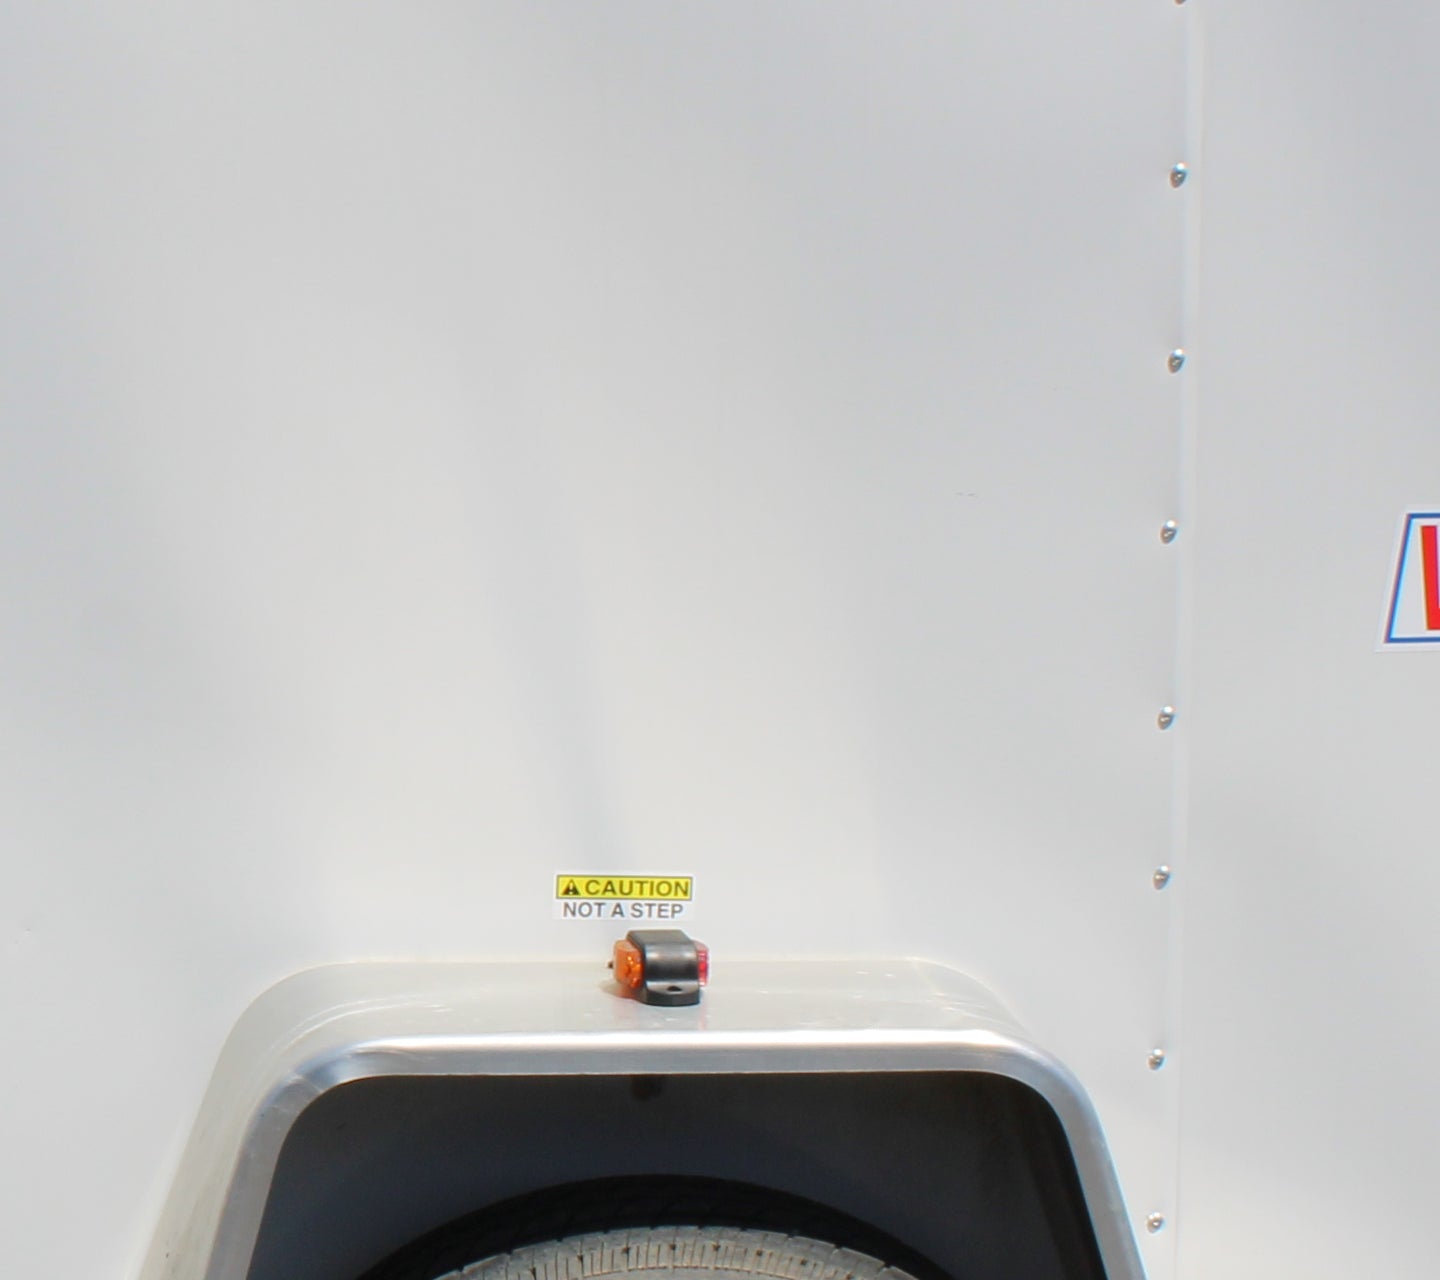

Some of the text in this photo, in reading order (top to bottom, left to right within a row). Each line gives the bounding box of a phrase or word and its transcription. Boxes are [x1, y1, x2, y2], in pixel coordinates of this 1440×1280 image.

[585, 880, 689, 896] CAUTION
[563, 902, 683, 919] NOT A STEP
